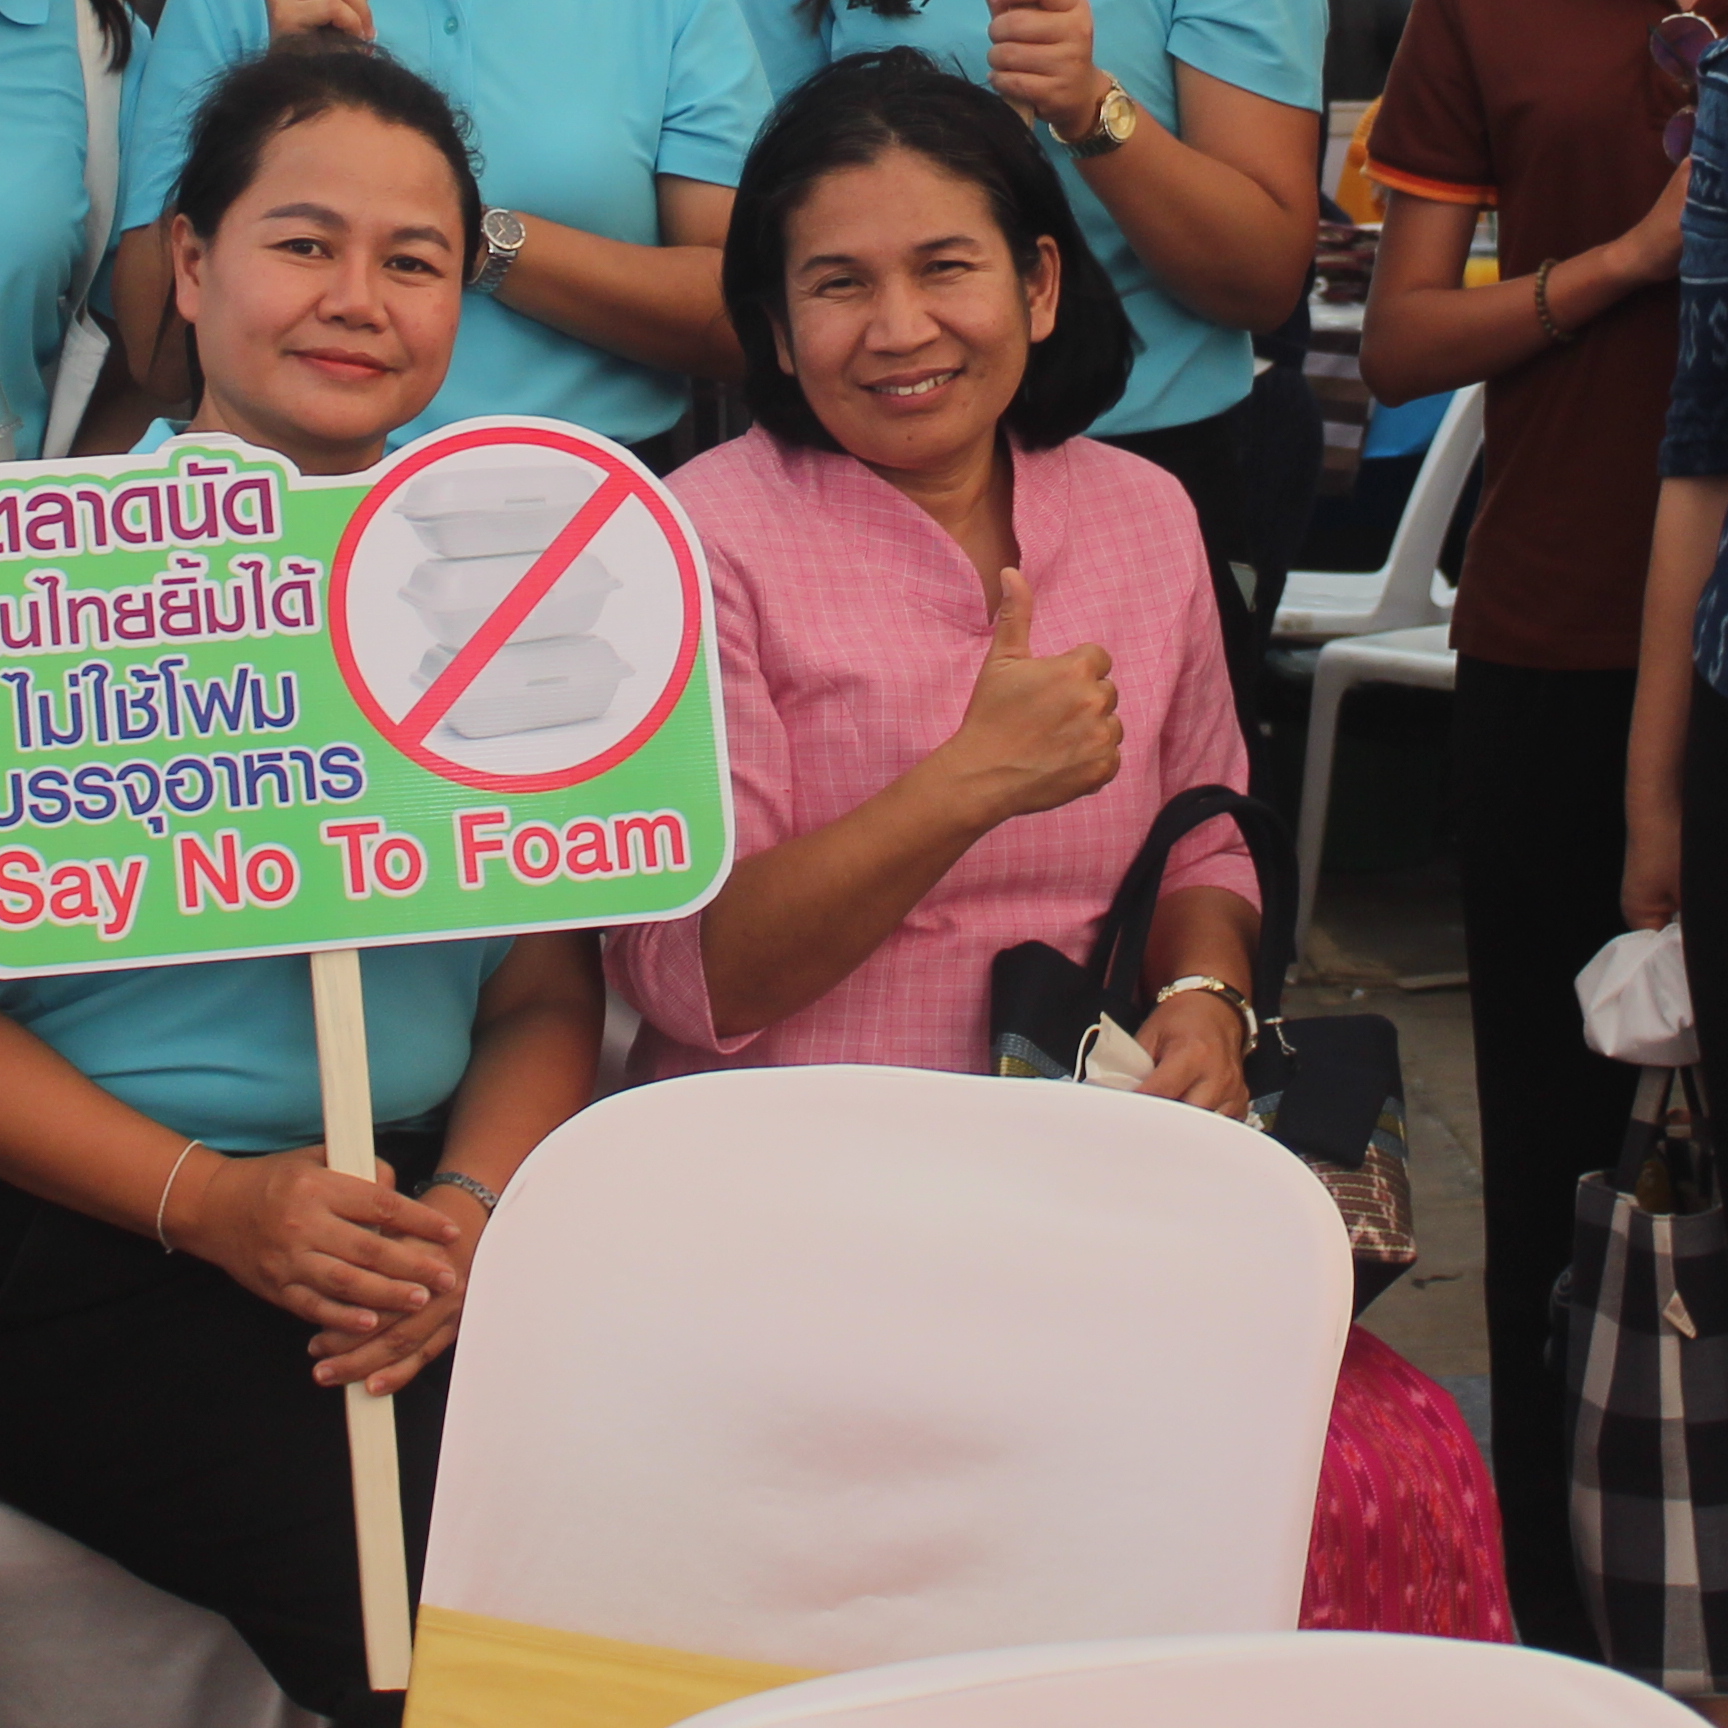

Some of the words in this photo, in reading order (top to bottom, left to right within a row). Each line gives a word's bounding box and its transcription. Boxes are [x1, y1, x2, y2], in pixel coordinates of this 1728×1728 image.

[6, 658, 296, 748] ไม่ใช้โฟม
[181, 836, 297, 912] No
[326, 821, 425, 896] To
[458, 810, 687, 887] Foam
